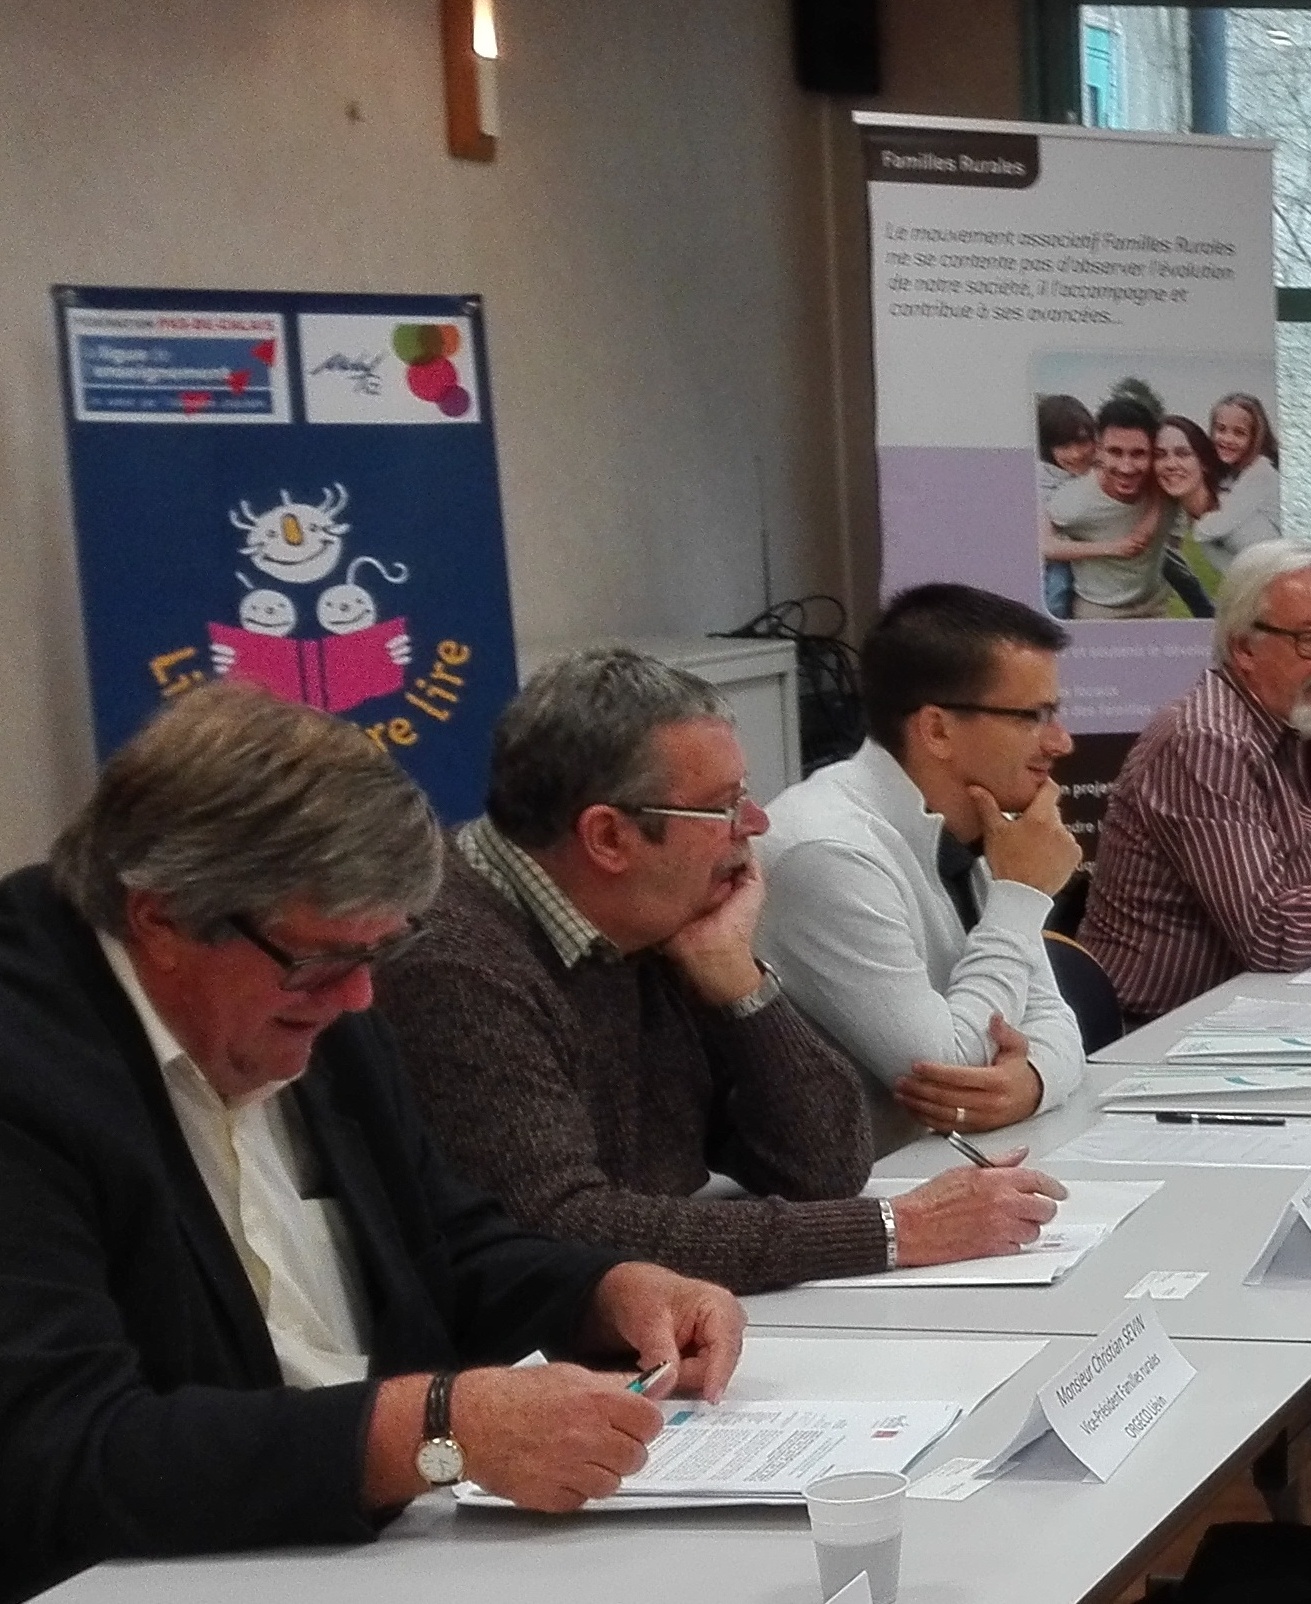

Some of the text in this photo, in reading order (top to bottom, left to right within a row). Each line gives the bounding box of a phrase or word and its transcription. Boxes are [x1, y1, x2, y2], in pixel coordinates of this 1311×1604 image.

[881, 149, 1026, 176] Familles Rurales
[1055, 1313, 1147, 1408] Monsieur Christian SEVIN
[1079, 1353, 1161, 1437] Vice-Président Familles rurales
[1124, 1409, 1152, 1440] ORGECO
